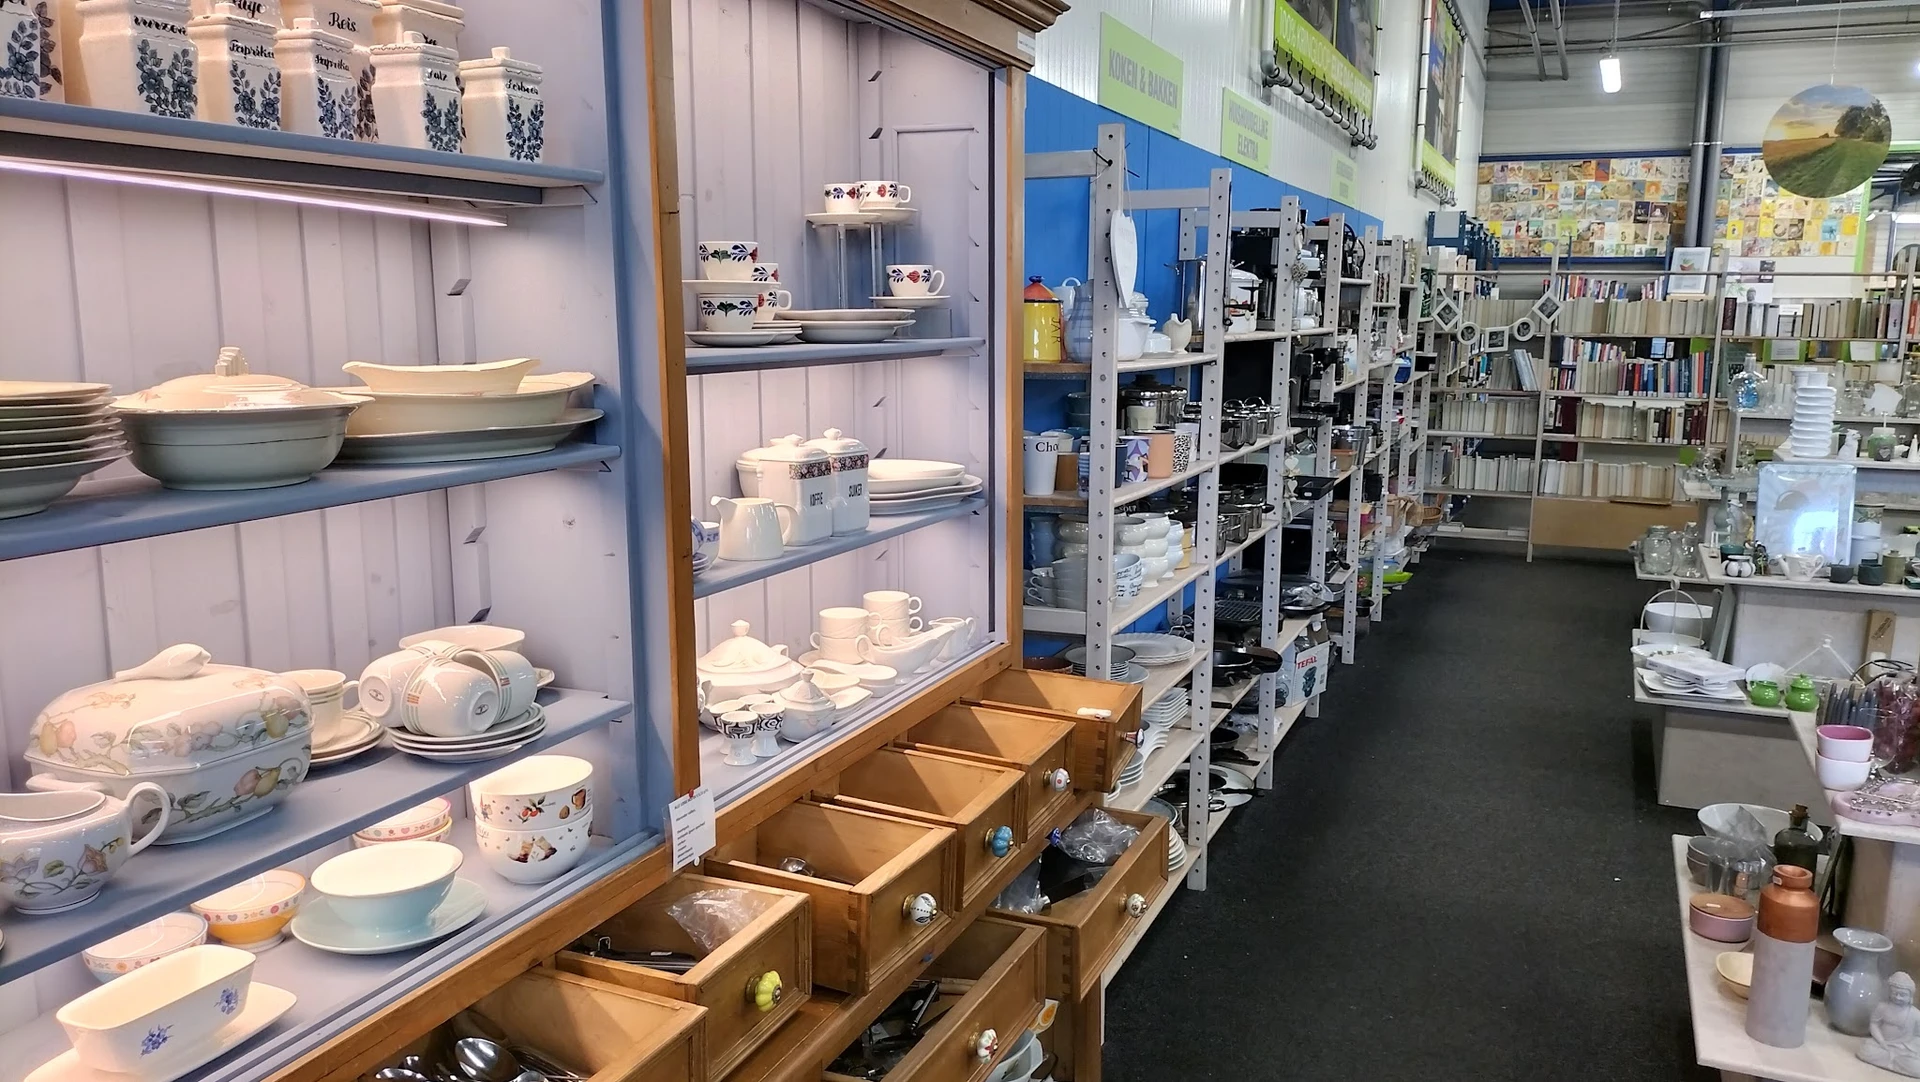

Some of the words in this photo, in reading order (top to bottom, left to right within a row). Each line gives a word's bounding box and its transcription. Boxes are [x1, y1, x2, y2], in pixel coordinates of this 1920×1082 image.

[328, 11, 357, 33] Reis
[229, 39, 275, 60] Paprika
[315, 54, 350, 72] Paprika
[1109, 48, 1138, 90] KOKEN
[1139, 66, 1147, 94] &
[1148, 70, 1178, 110] BAKKEN
[1237, 132, 1259, 161] ELEKTRA
[810, 492, 822, 507] KOFFIE
[849, 484, 862, 497] SUIKER
[1297, 656, 1317, 669] TEFAL
